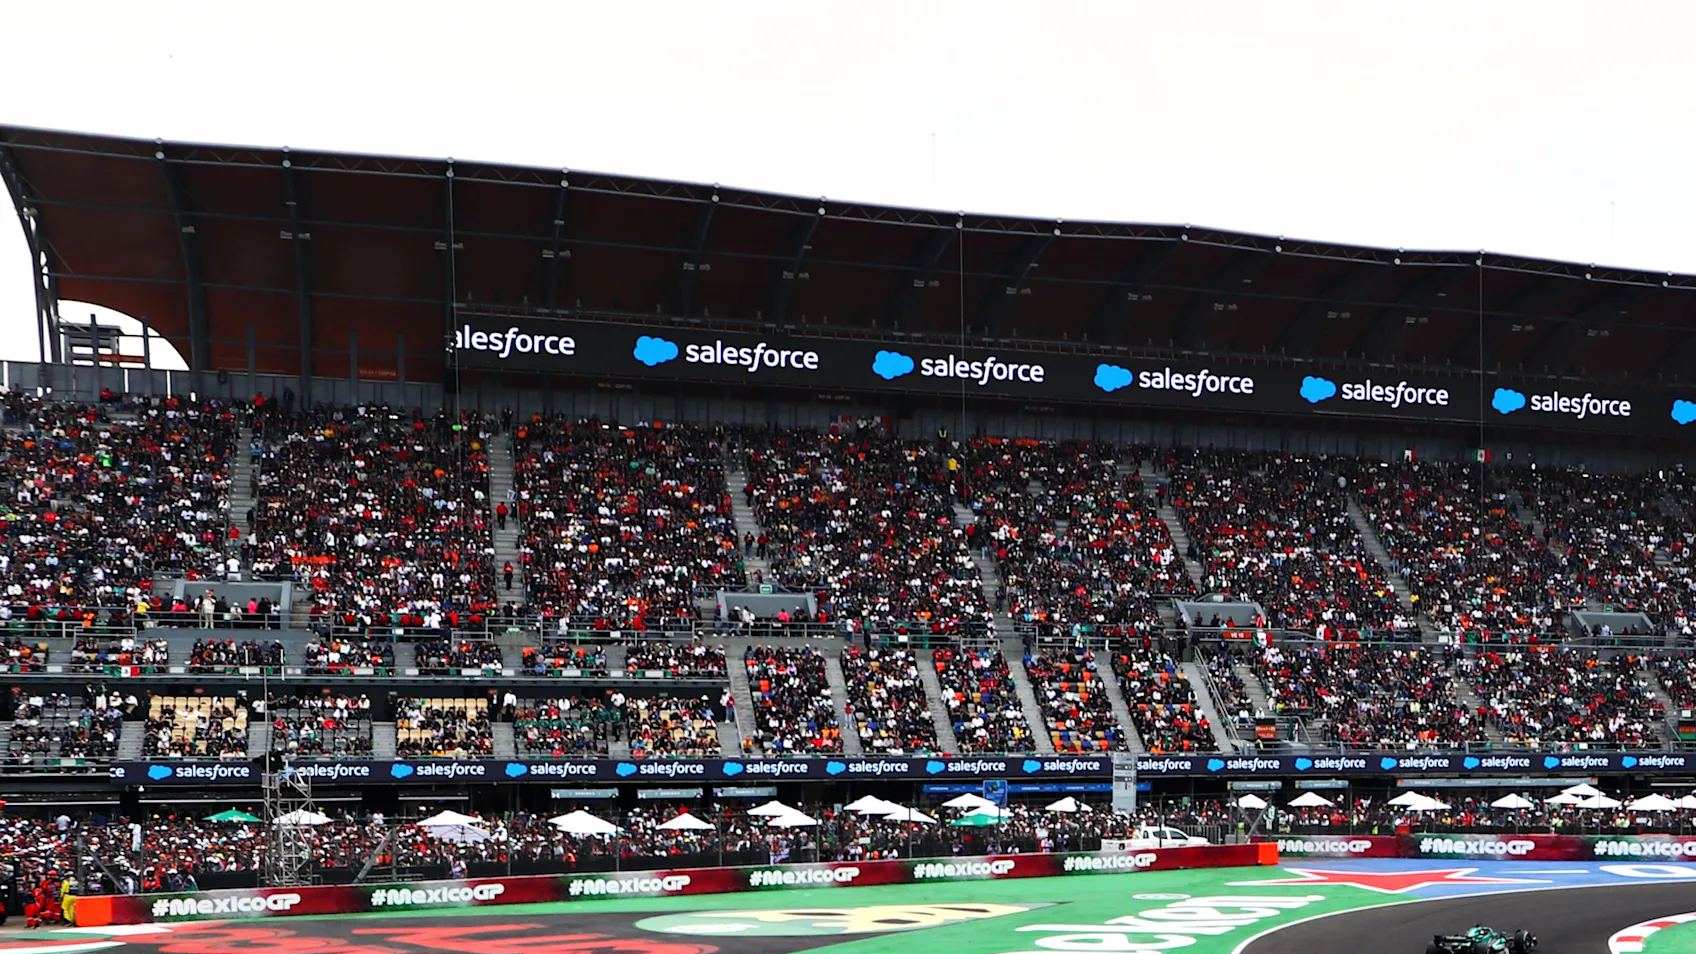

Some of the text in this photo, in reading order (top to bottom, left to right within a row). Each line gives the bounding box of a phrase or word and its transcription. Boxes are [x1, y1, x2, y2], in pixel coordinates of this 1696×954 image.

[686, 340, 819, 372] salesforce
[921, 354, 1044, 385] salesforce
[1139, 368, 1254, 396] salesforce
[1341, 379, 1448, 408] salesforce
[1530, 390, 1631, 419] salesforce
[530, 762, 597, 777] salesforce
[640, 762, 704, 776] salesforce
[746, 760, 808, 775] salesforce
[848, 760, 909, 775] salesforce
[947, 759, 1006, 774] salesforce
[1043, 758, 1100, 773] salesforce
[1136, 758, 1192, 773] salesforce
[1226, 757, 1280, 771] salesforce
[1314, 757, 1366, 770] salesforce
[1398, 756, 1450, 770] salesforce
[1481, 756, 1531, 770] salesforce
[1561, 756, 1609, 769] salesforce
[1639, 755, 1685, 769] salesforce
[176, 765, 250, 780] salesforce
[416, 763, 485, 778] salesforce
[1277, 839, 1372, 853] #MexicoGP
[1419, 838, 1535, 855] #MexicoGP
[913, 859, 1015, 879] #MexicoGP
[1063, 852, 1157, 872] #MexicoGP
[749, 866, 860, 886] #MexicoGP
[569, 875, 691, 896] #MexicoGP
[370, 884, 504, 906] #MexicoGP
[152, 893, 301, 917] #MexicoGP
